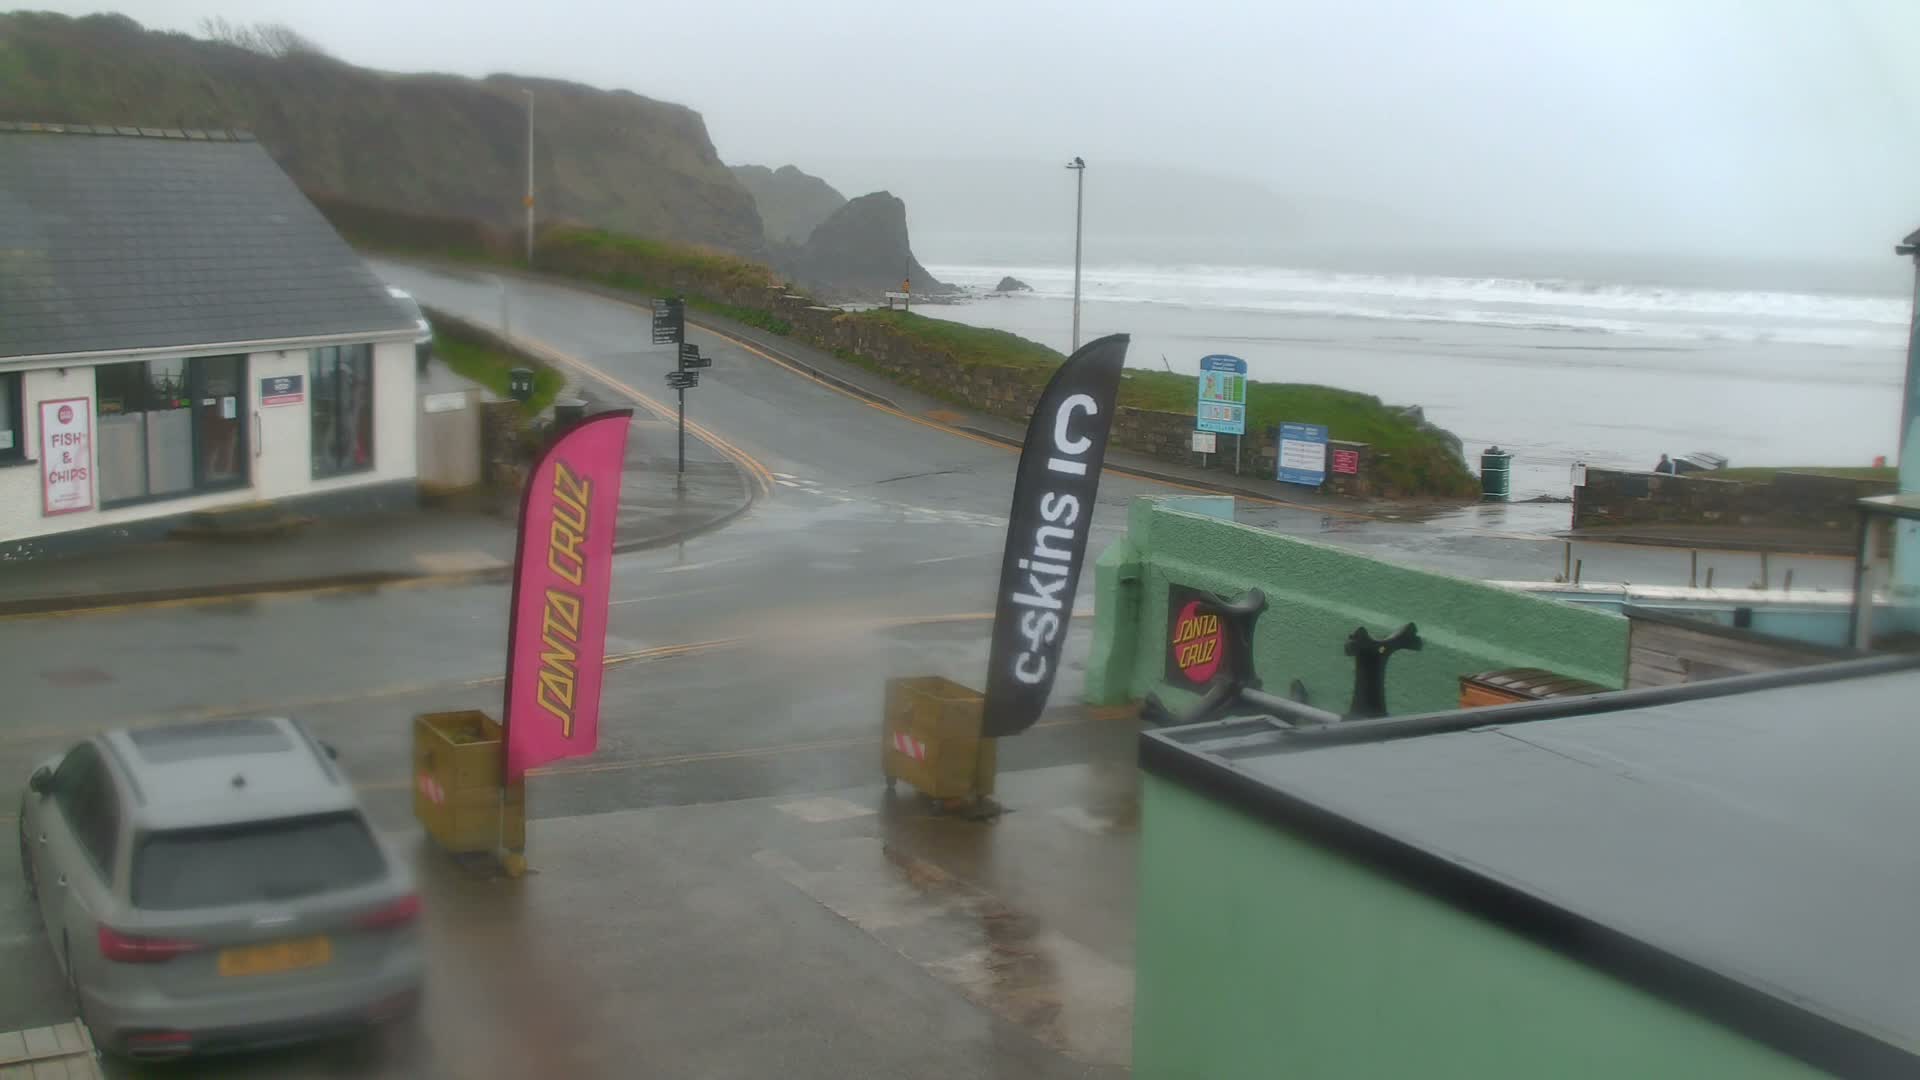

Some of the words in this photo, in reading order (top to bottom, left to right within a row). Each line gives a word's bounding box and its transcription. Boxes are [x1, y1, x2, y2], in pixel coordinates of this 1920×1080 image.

[51, 432, 81, 448] FISH
[62, 451, 73, 464] &
[49, 467, 87, 484] CHIPS
[547, 461, 591, 587] CRUZ
[1012, 492, 1079, 684] c-skins
[1172, 615, 1218, 645] SANTA
[536, 589, 585, 738] SANTA
[1178, 638, 1218, 669] CRUZ
